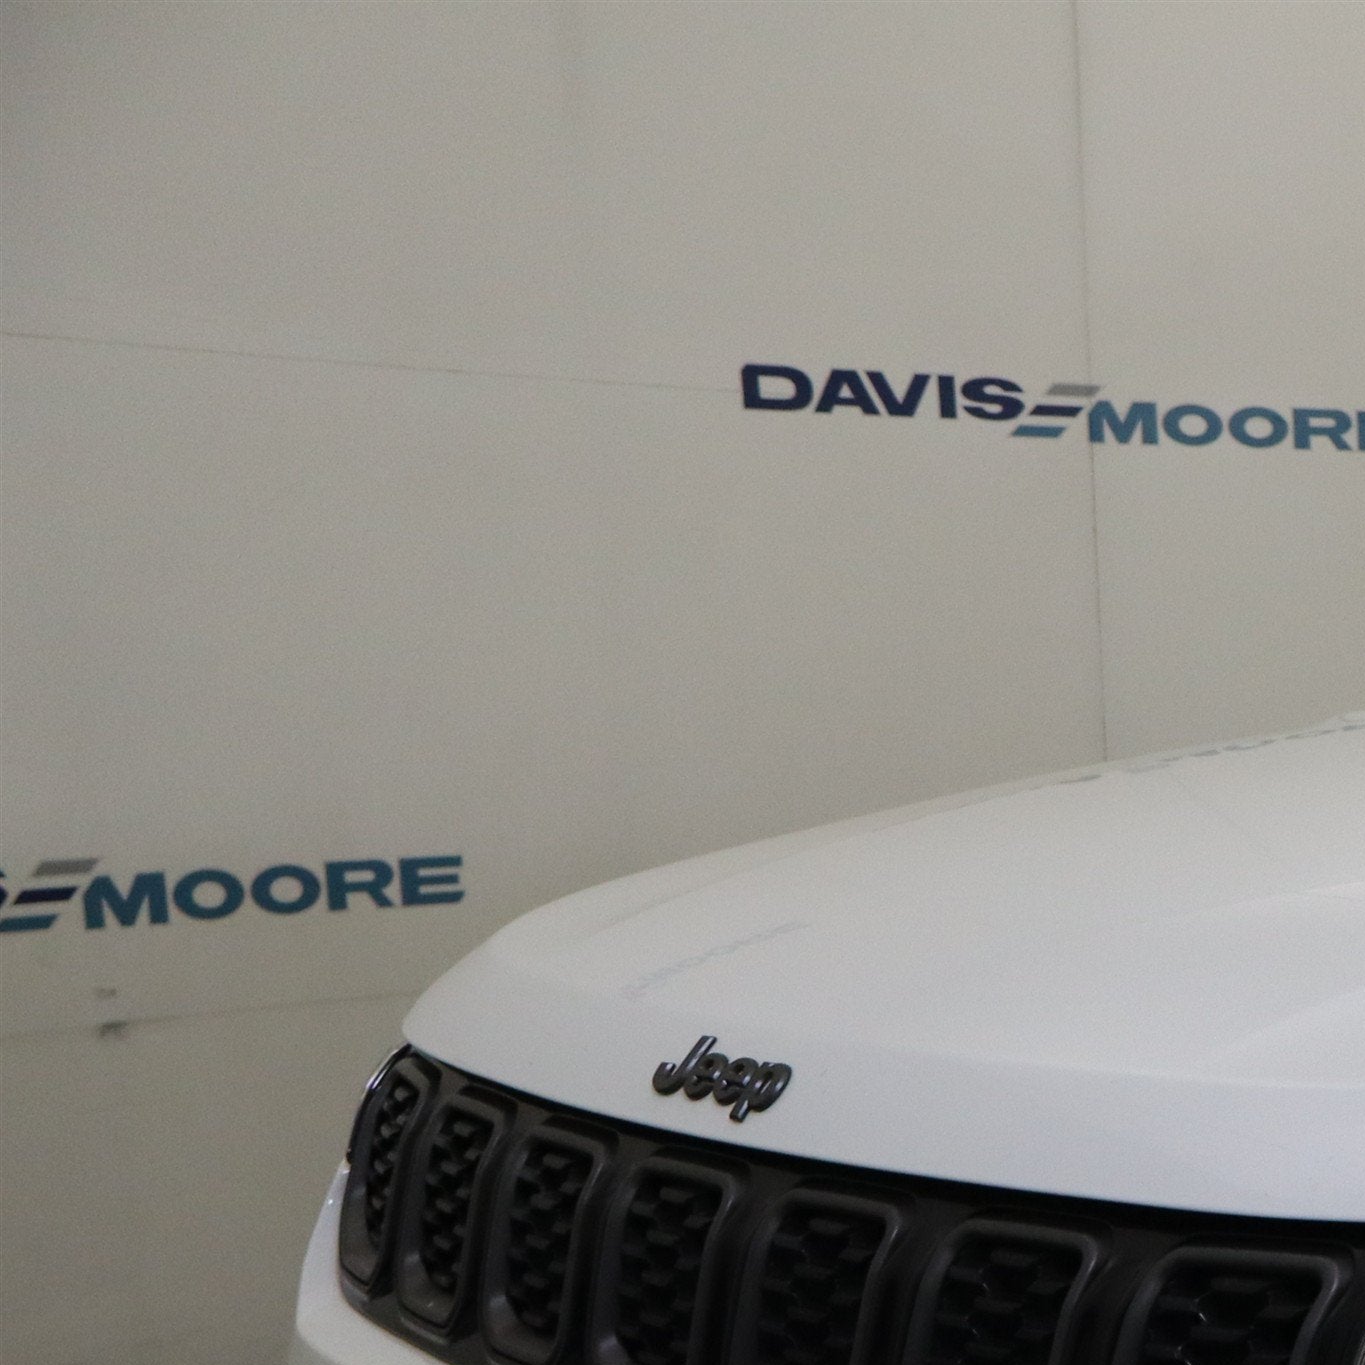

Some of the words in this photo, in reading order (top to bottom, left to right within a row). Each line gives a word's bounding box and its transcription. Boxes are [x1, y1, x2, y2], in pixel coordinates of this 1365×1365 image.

[739, 362, 1026, 422] DAVIS
[82, 855, 466, 931] MOORE
[651, 1035, 793, 1123] Jeep
